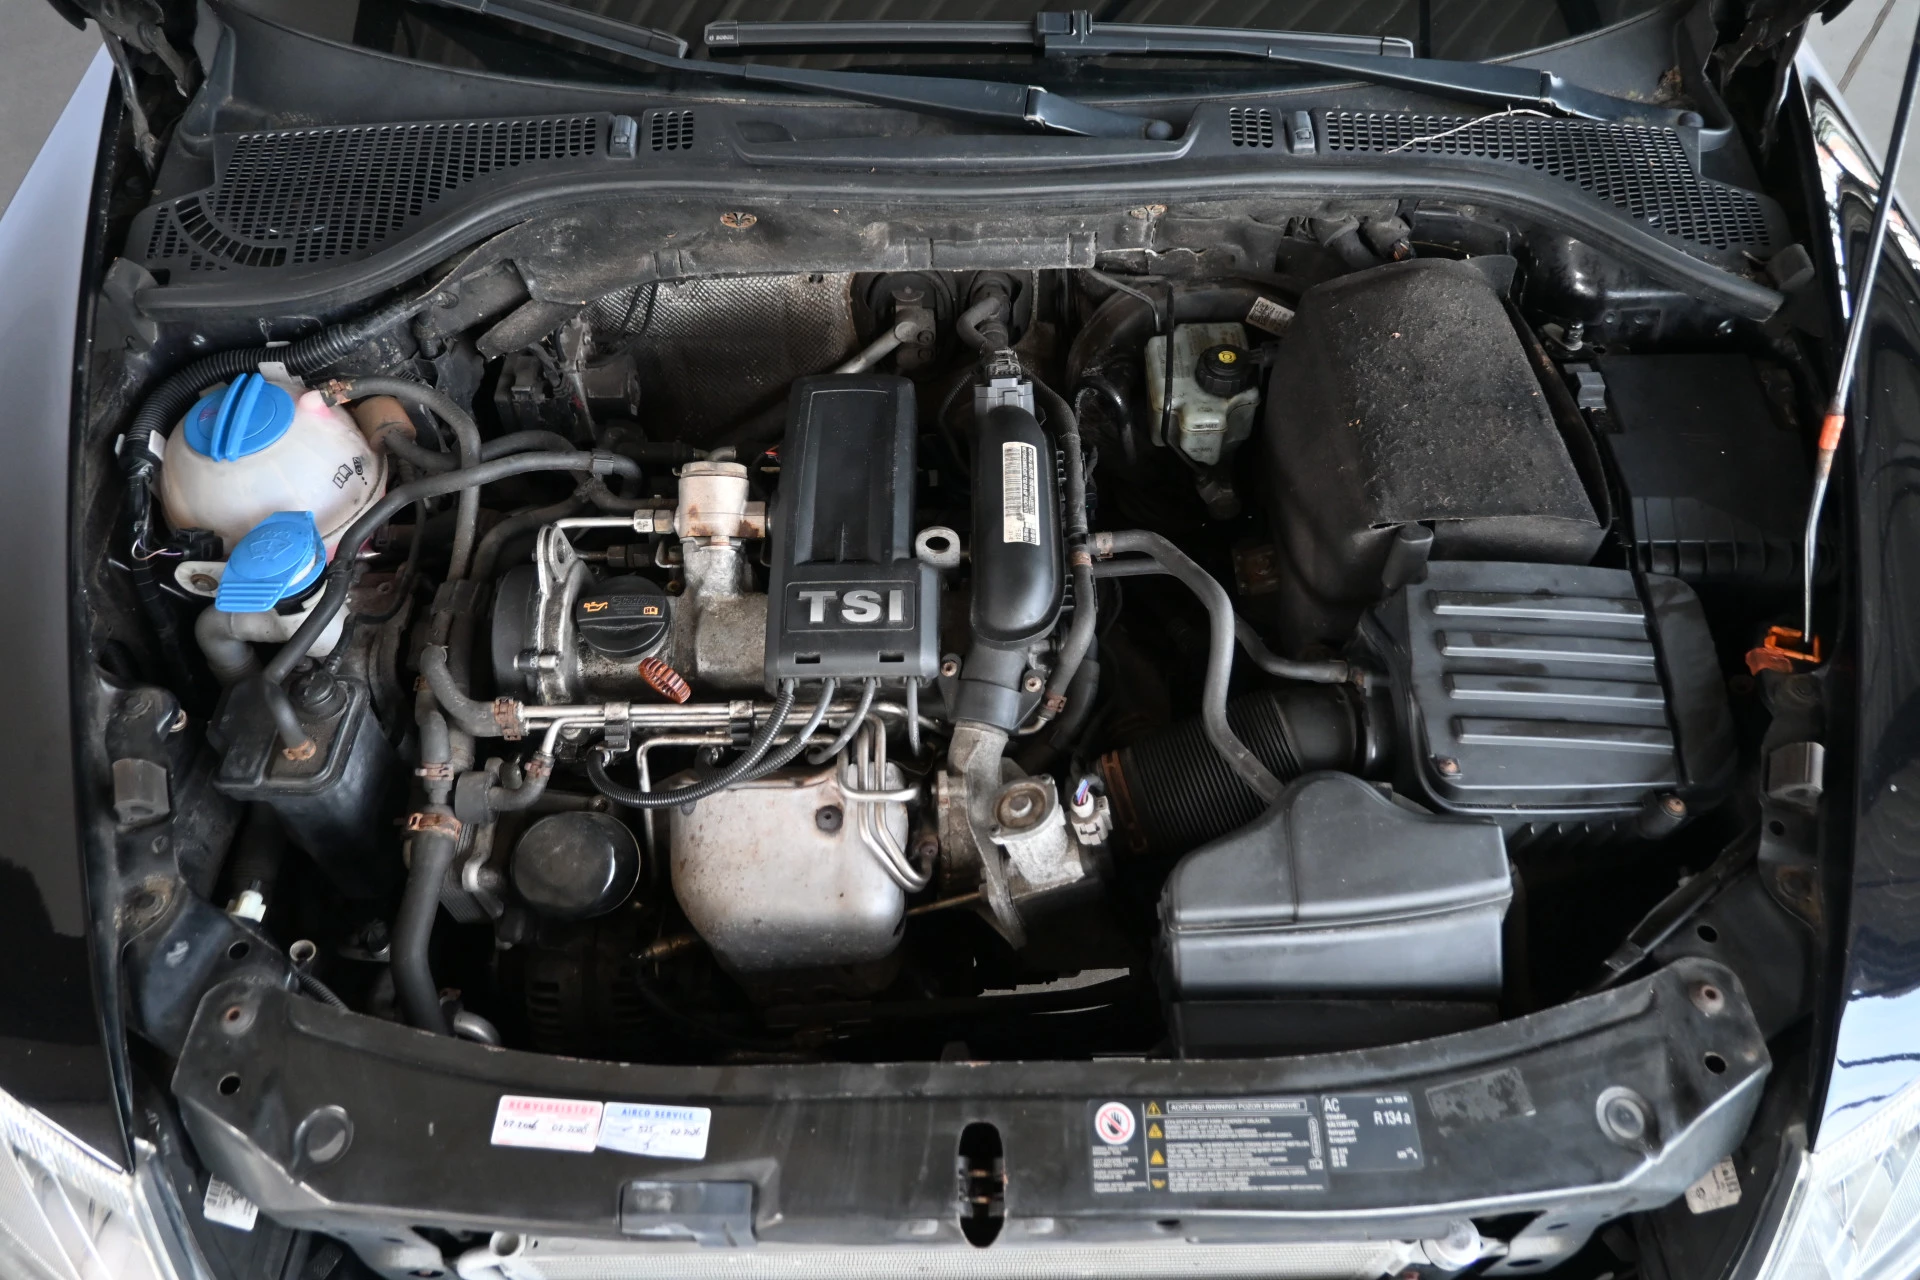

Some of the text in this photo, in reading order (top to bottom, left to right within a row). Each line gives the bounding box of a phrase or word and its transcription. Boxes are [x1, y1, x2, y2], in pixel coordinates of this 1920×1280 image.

[798, 590, 904, 624] TSI
[1205, 1103, 1237, 1111] WARNING!
[1324, 1097, 1340, 1112] AC
[621, 1107, 694, 1121] AIRCO SERVICE
[1373, 1110, 1384, 1125] R
[1384, 1110, 1403, 1125] 134
